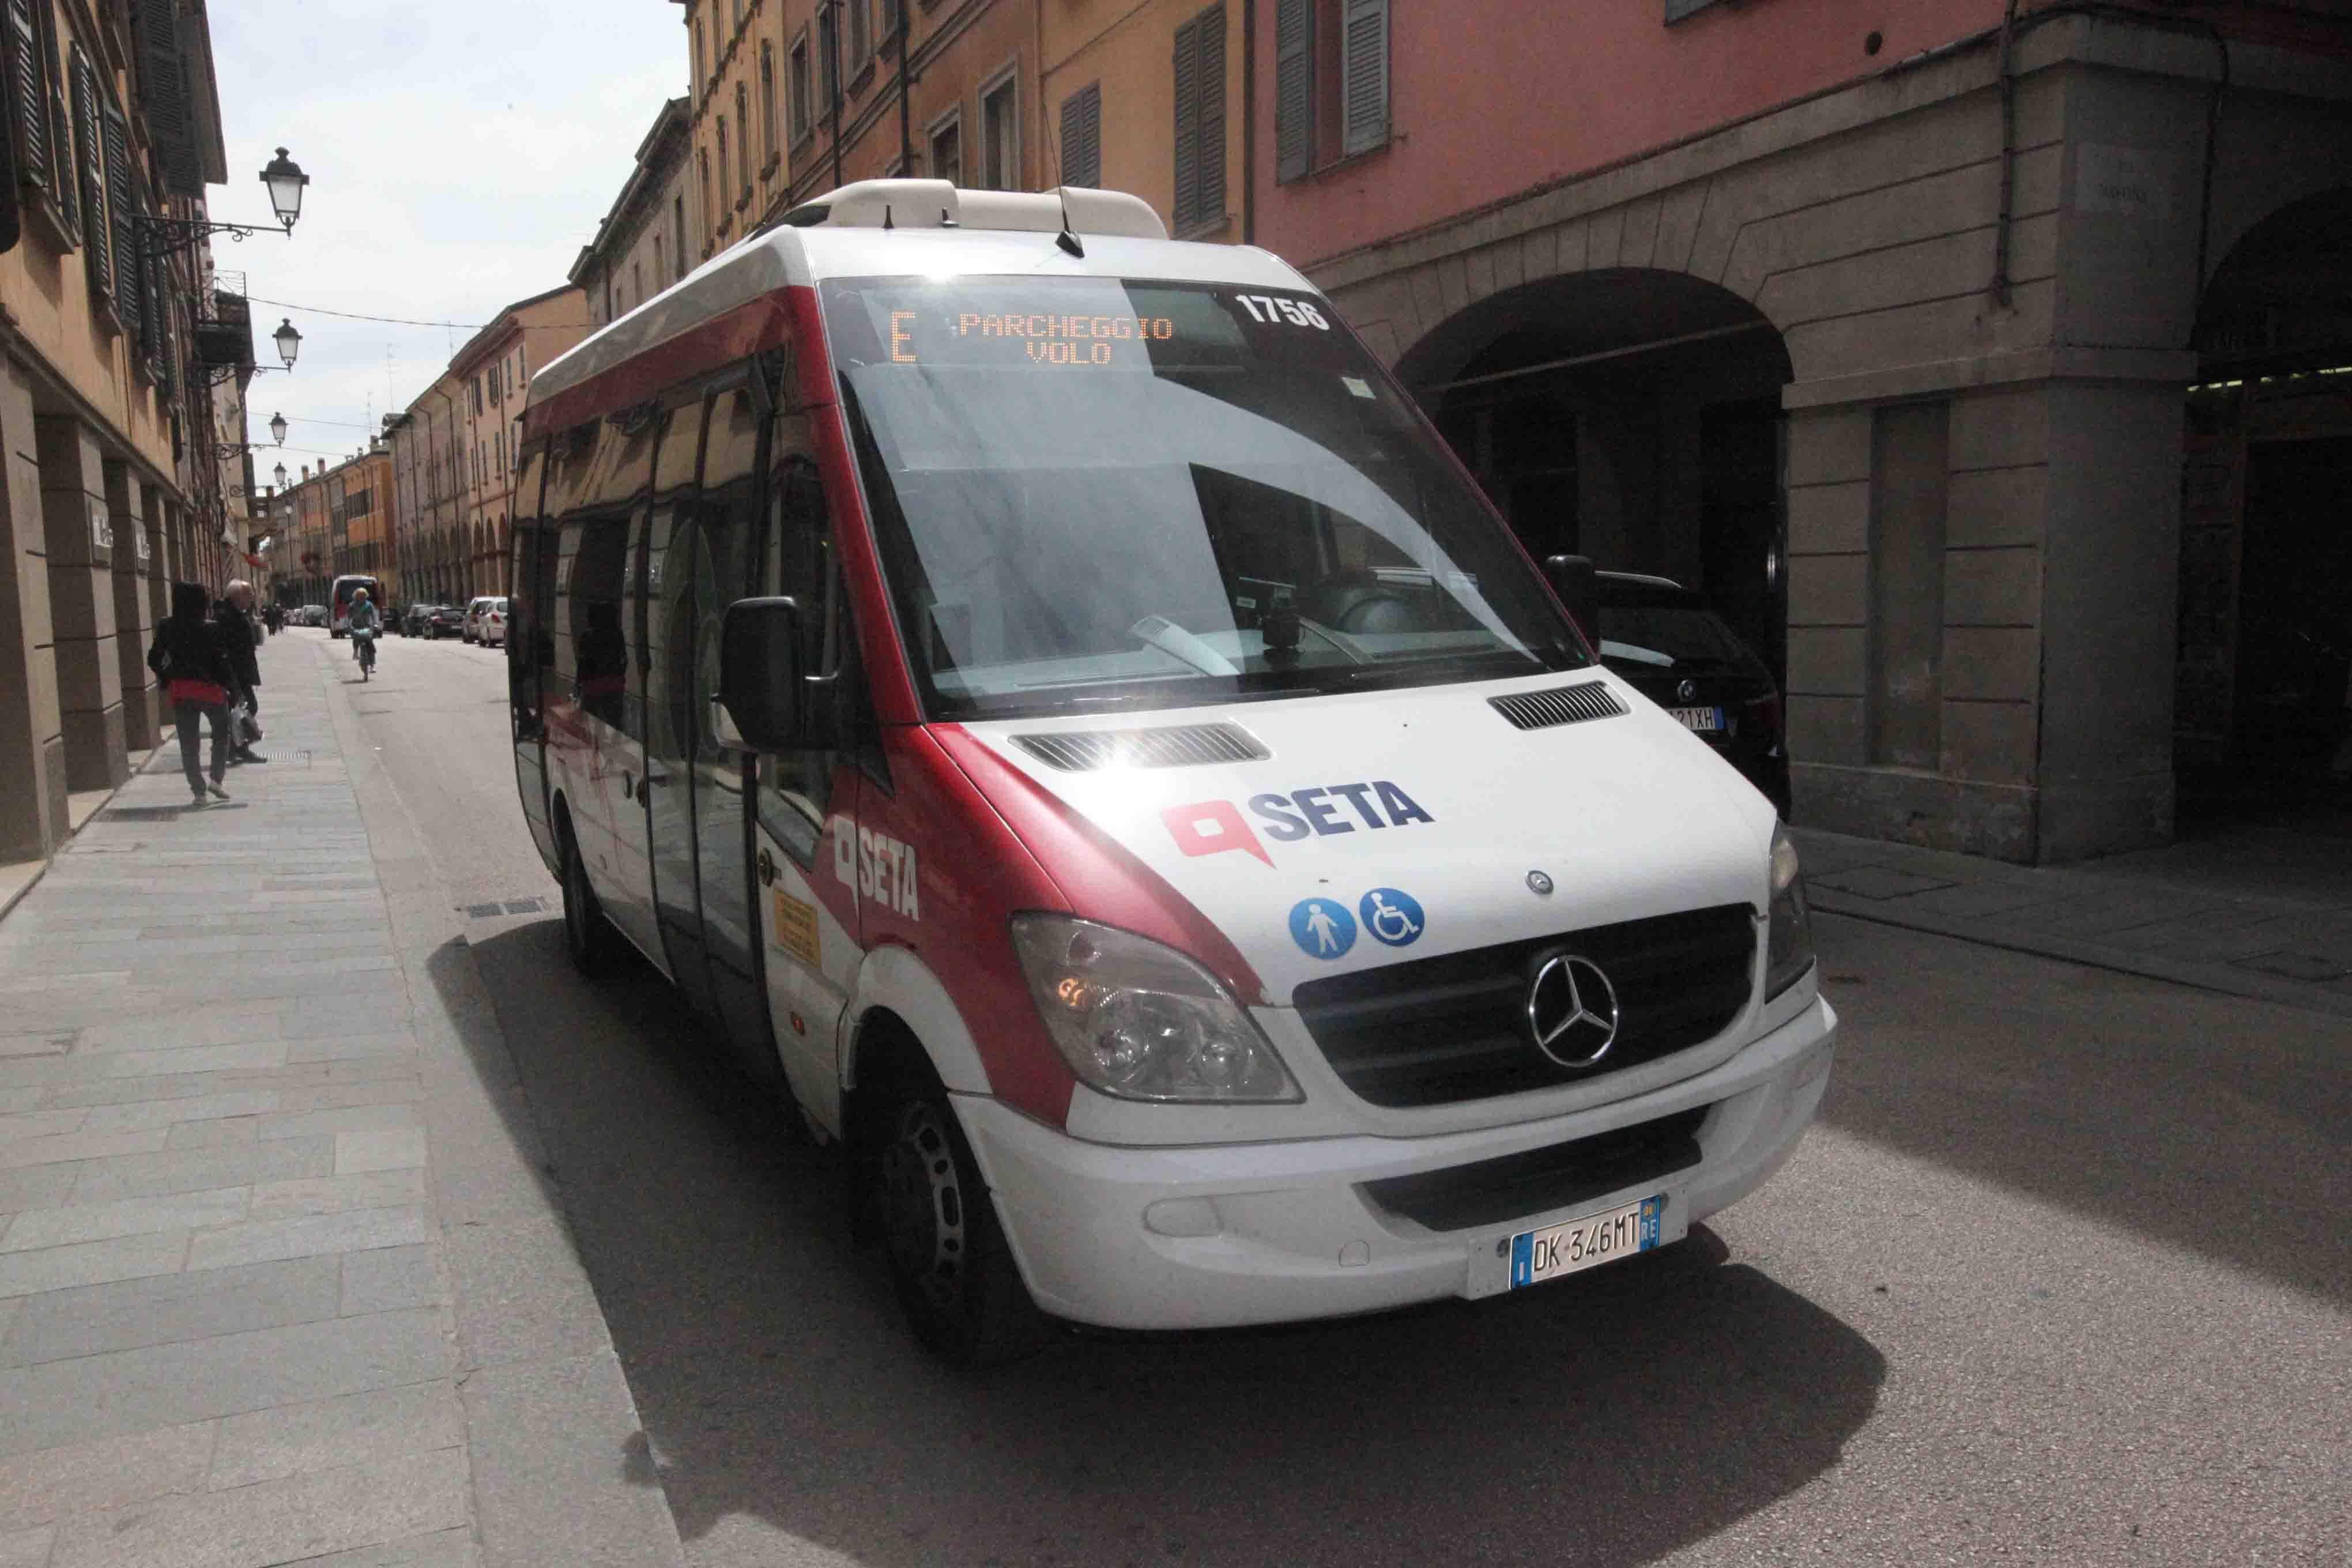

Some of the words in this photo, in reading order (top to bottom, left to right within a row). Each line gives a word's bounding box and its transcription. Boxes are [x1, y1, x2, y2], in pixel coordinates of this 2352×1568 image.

[889, 311, 917, 363] E
[959, 314, 1173, 341] PARCHEGGIO
[1235, 294, 1331, 331] 1756
[1026, 341, 1113, 365] VOLO
[1669, 708, 1713, 728] 21XH
[1247, 781, 1435, 842] SETA
[858, 826, 920, 922] SETA
[1534, 1233, 1564, 1272] DK
[1569, 1212, 1638, 1261] 346MT
[1641, 1219, 1657, 1242] RE
